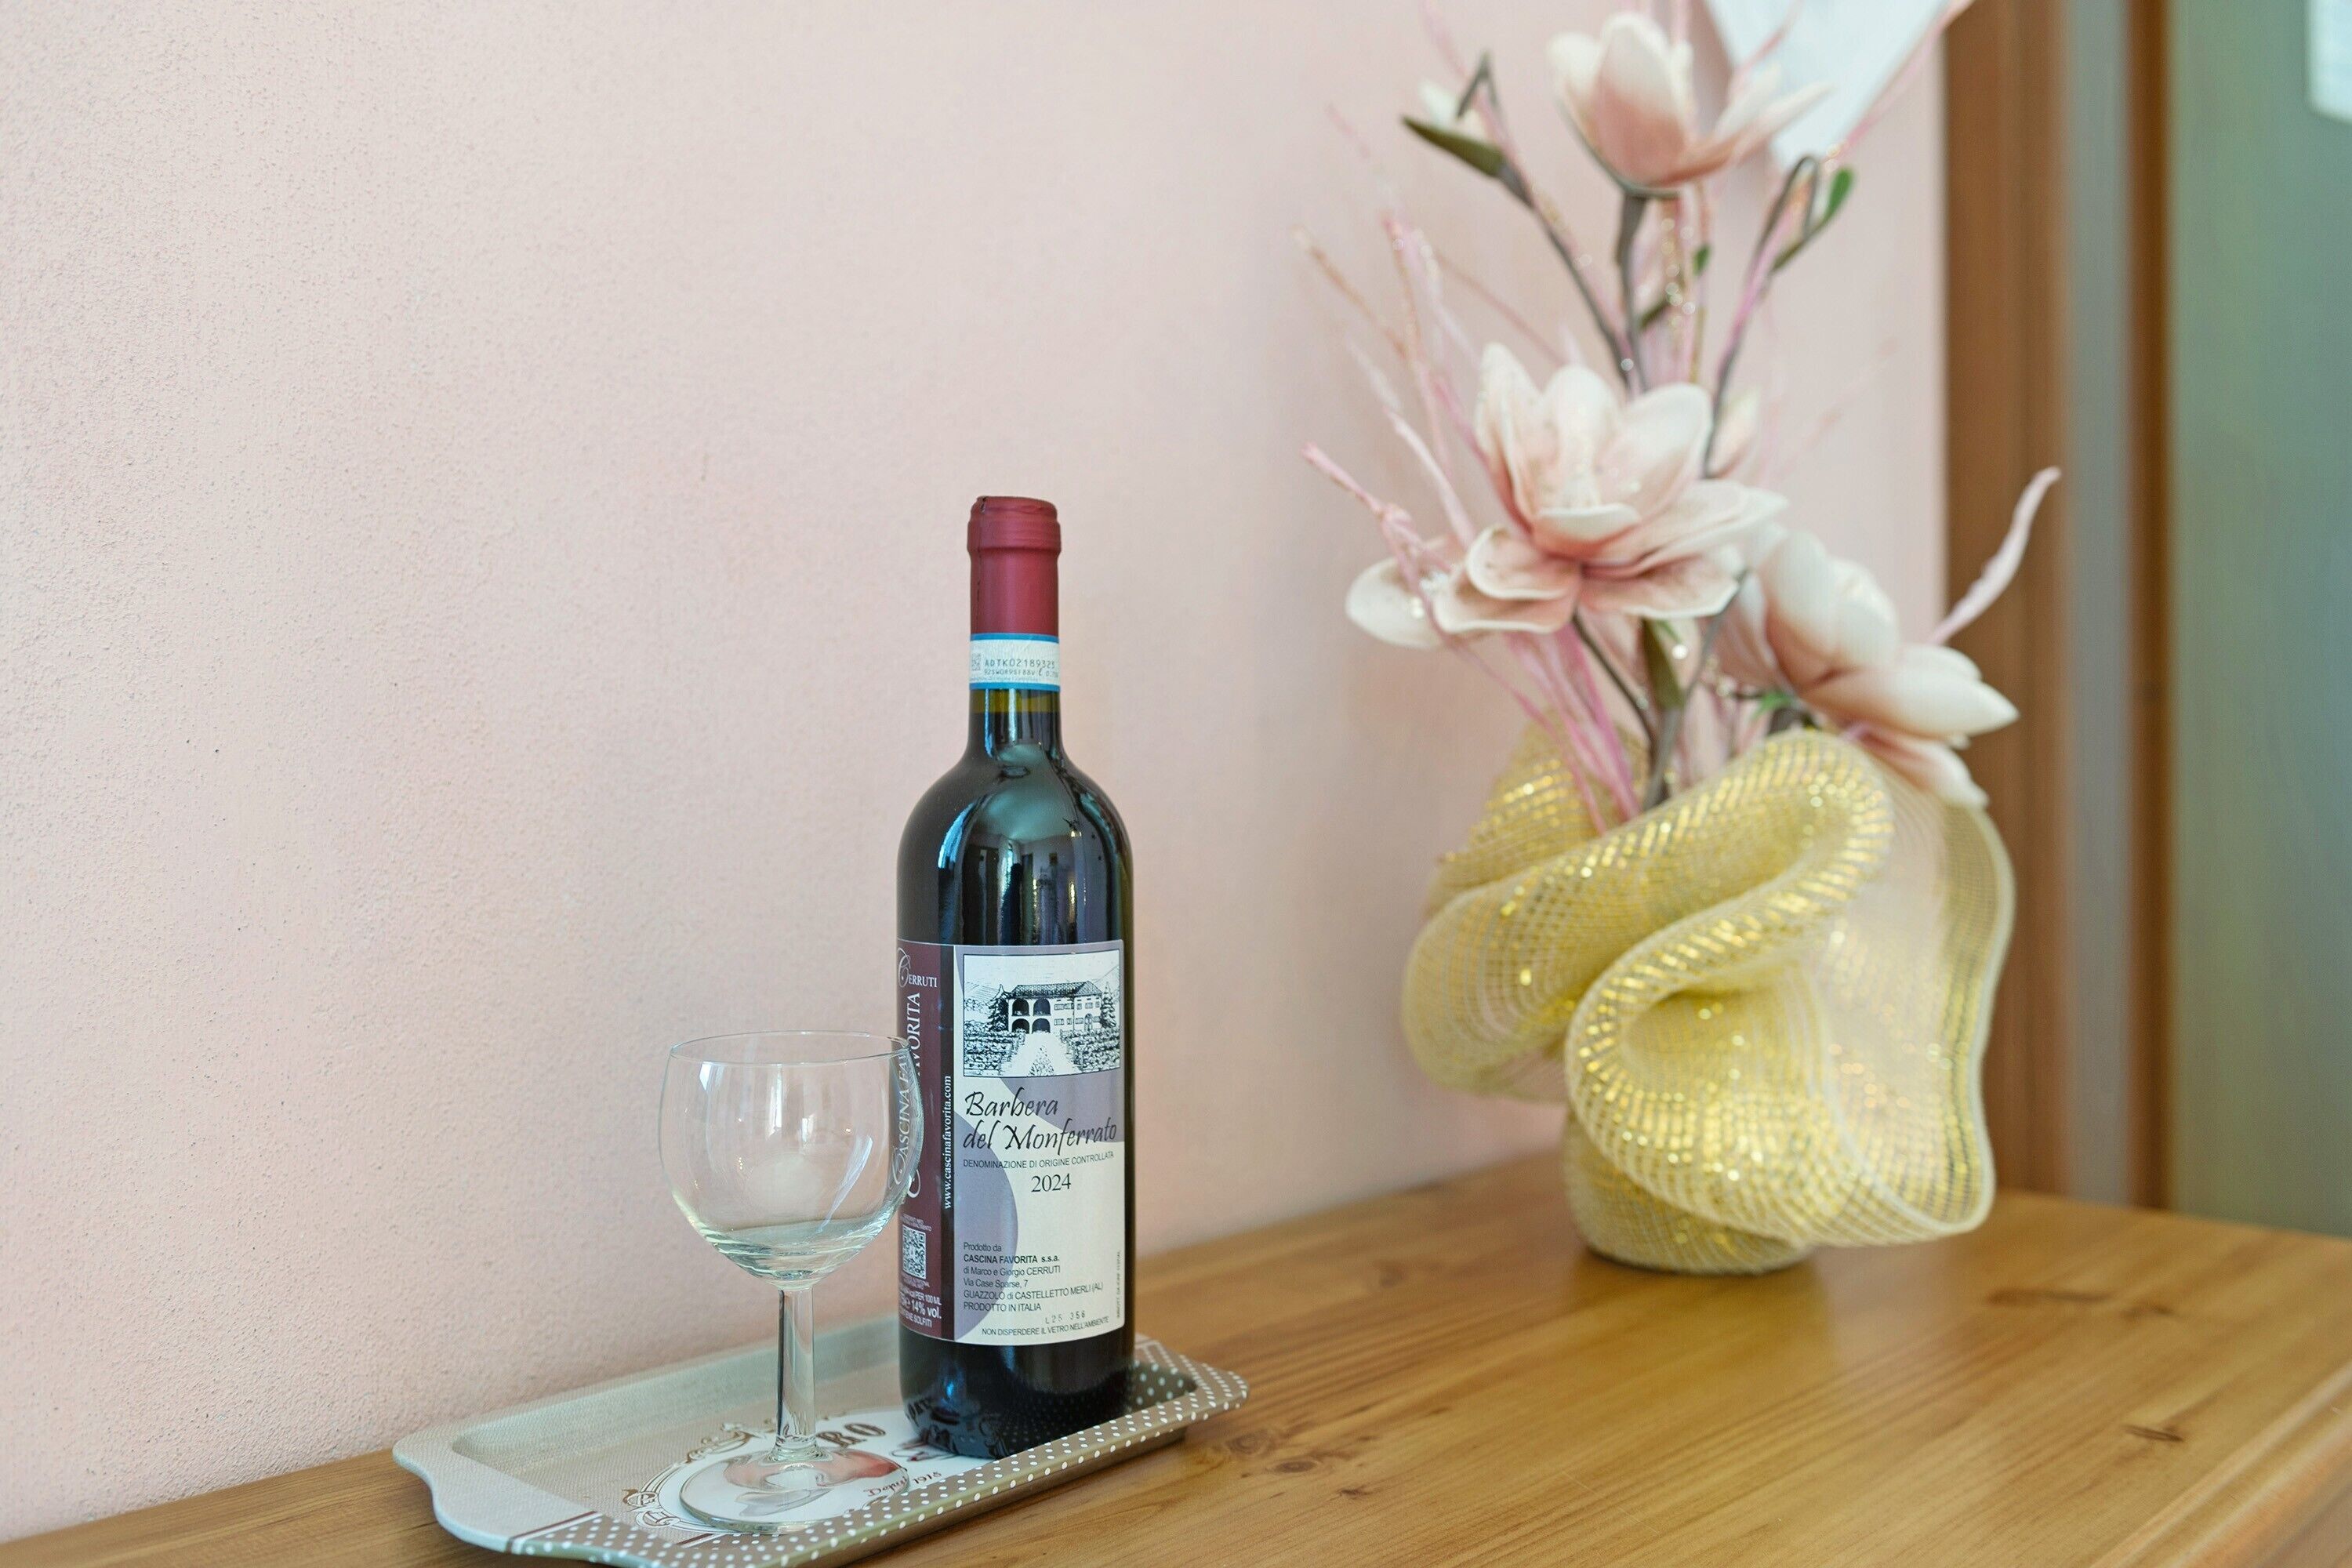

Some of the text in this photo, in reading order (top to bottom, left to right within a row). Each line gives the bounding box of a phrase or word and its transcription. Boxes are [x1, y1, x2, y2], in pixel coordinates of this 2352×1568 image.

[898, 946, 938, 988] CERRUTI
[964, 1087, 1058, 1116] Barbera
[942, 1075, 952, 1209] www.cascinafavorita.com
[963, 1116, 1116, 1156] del Monferrato
[963, 1159, 1027, 1169] DENOMINAZIONE
[1039, 1157, 1070, 1167] ORIGINE
[1071, 1151, 1115, 1165] CONTROLLATA
[1031, 1173, 1072, 1192] 2024
[964, 1242, 992, 1252] Prodotto
[964, 1255, 997, 1264] CASCINA
[999, 1255, 1038, 1264] FAVORITA
[964, 1266, 969, 1275] di
[1000, 1267, 1025, 1278] Giorgio
[1026, 1265, 1061, 1276] CERRUTI
[975, 1279, 993, 1287] Case
[964, 1290, 1005, 1300] GUAZZOLO
[1014, 1287, 1069, 1300] CASTELLETTO
[1070, 1284, 1091, 1295] MERLI
[910, 1299, 926, 1316] 14%
[927, 1305, 942, 1319] vol.
[964, 1302, 1041, 1312] PRODOTTO IN ITALIA
[982, 1327, 996, 1336] NON
[997, 1327, 1040, 1336] DISPERDERE
[1047, 1325, 1069, 1334] VETRO
